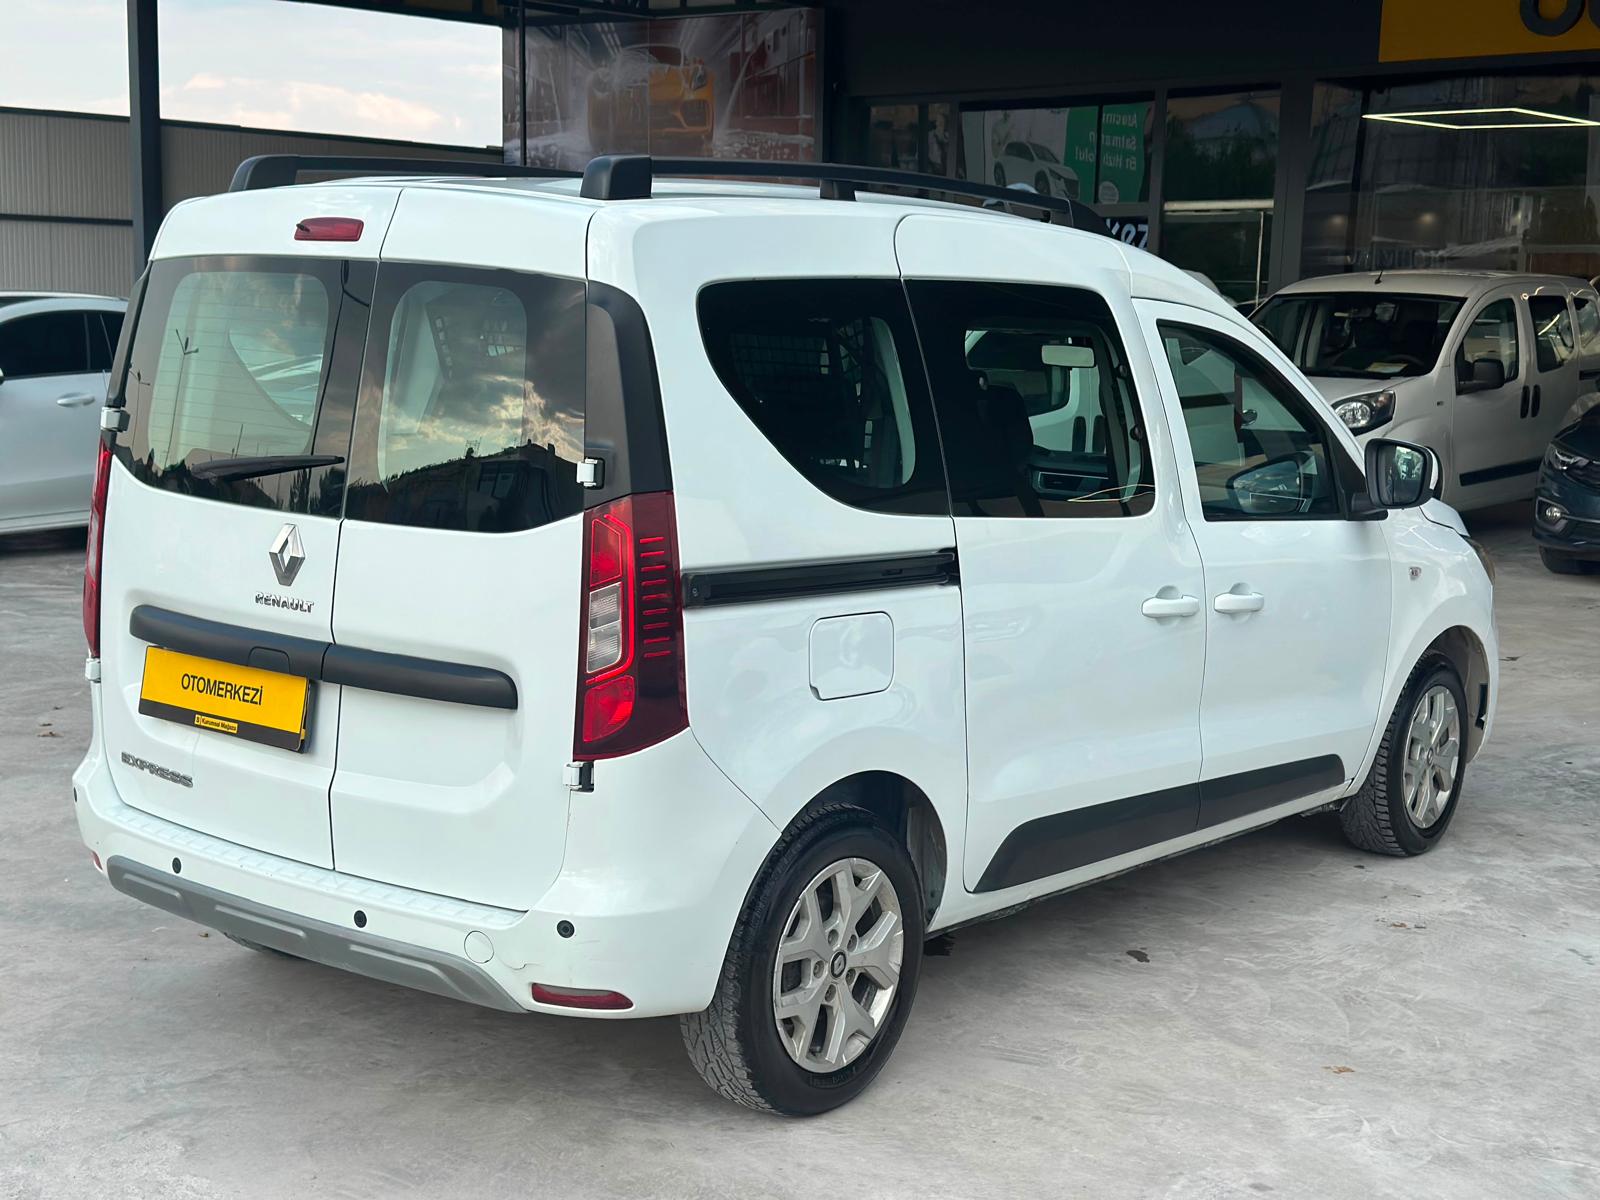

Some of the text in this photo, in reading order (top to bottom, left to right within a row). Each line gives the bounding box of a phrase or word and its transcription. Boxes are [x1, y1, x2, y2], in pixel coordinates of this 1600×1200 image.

[255, 591, 314, 613] RENAULT
[181, 673, 263, 705] OTOMERKEZİ
[121, 752, 193, 788] EXPRESS
